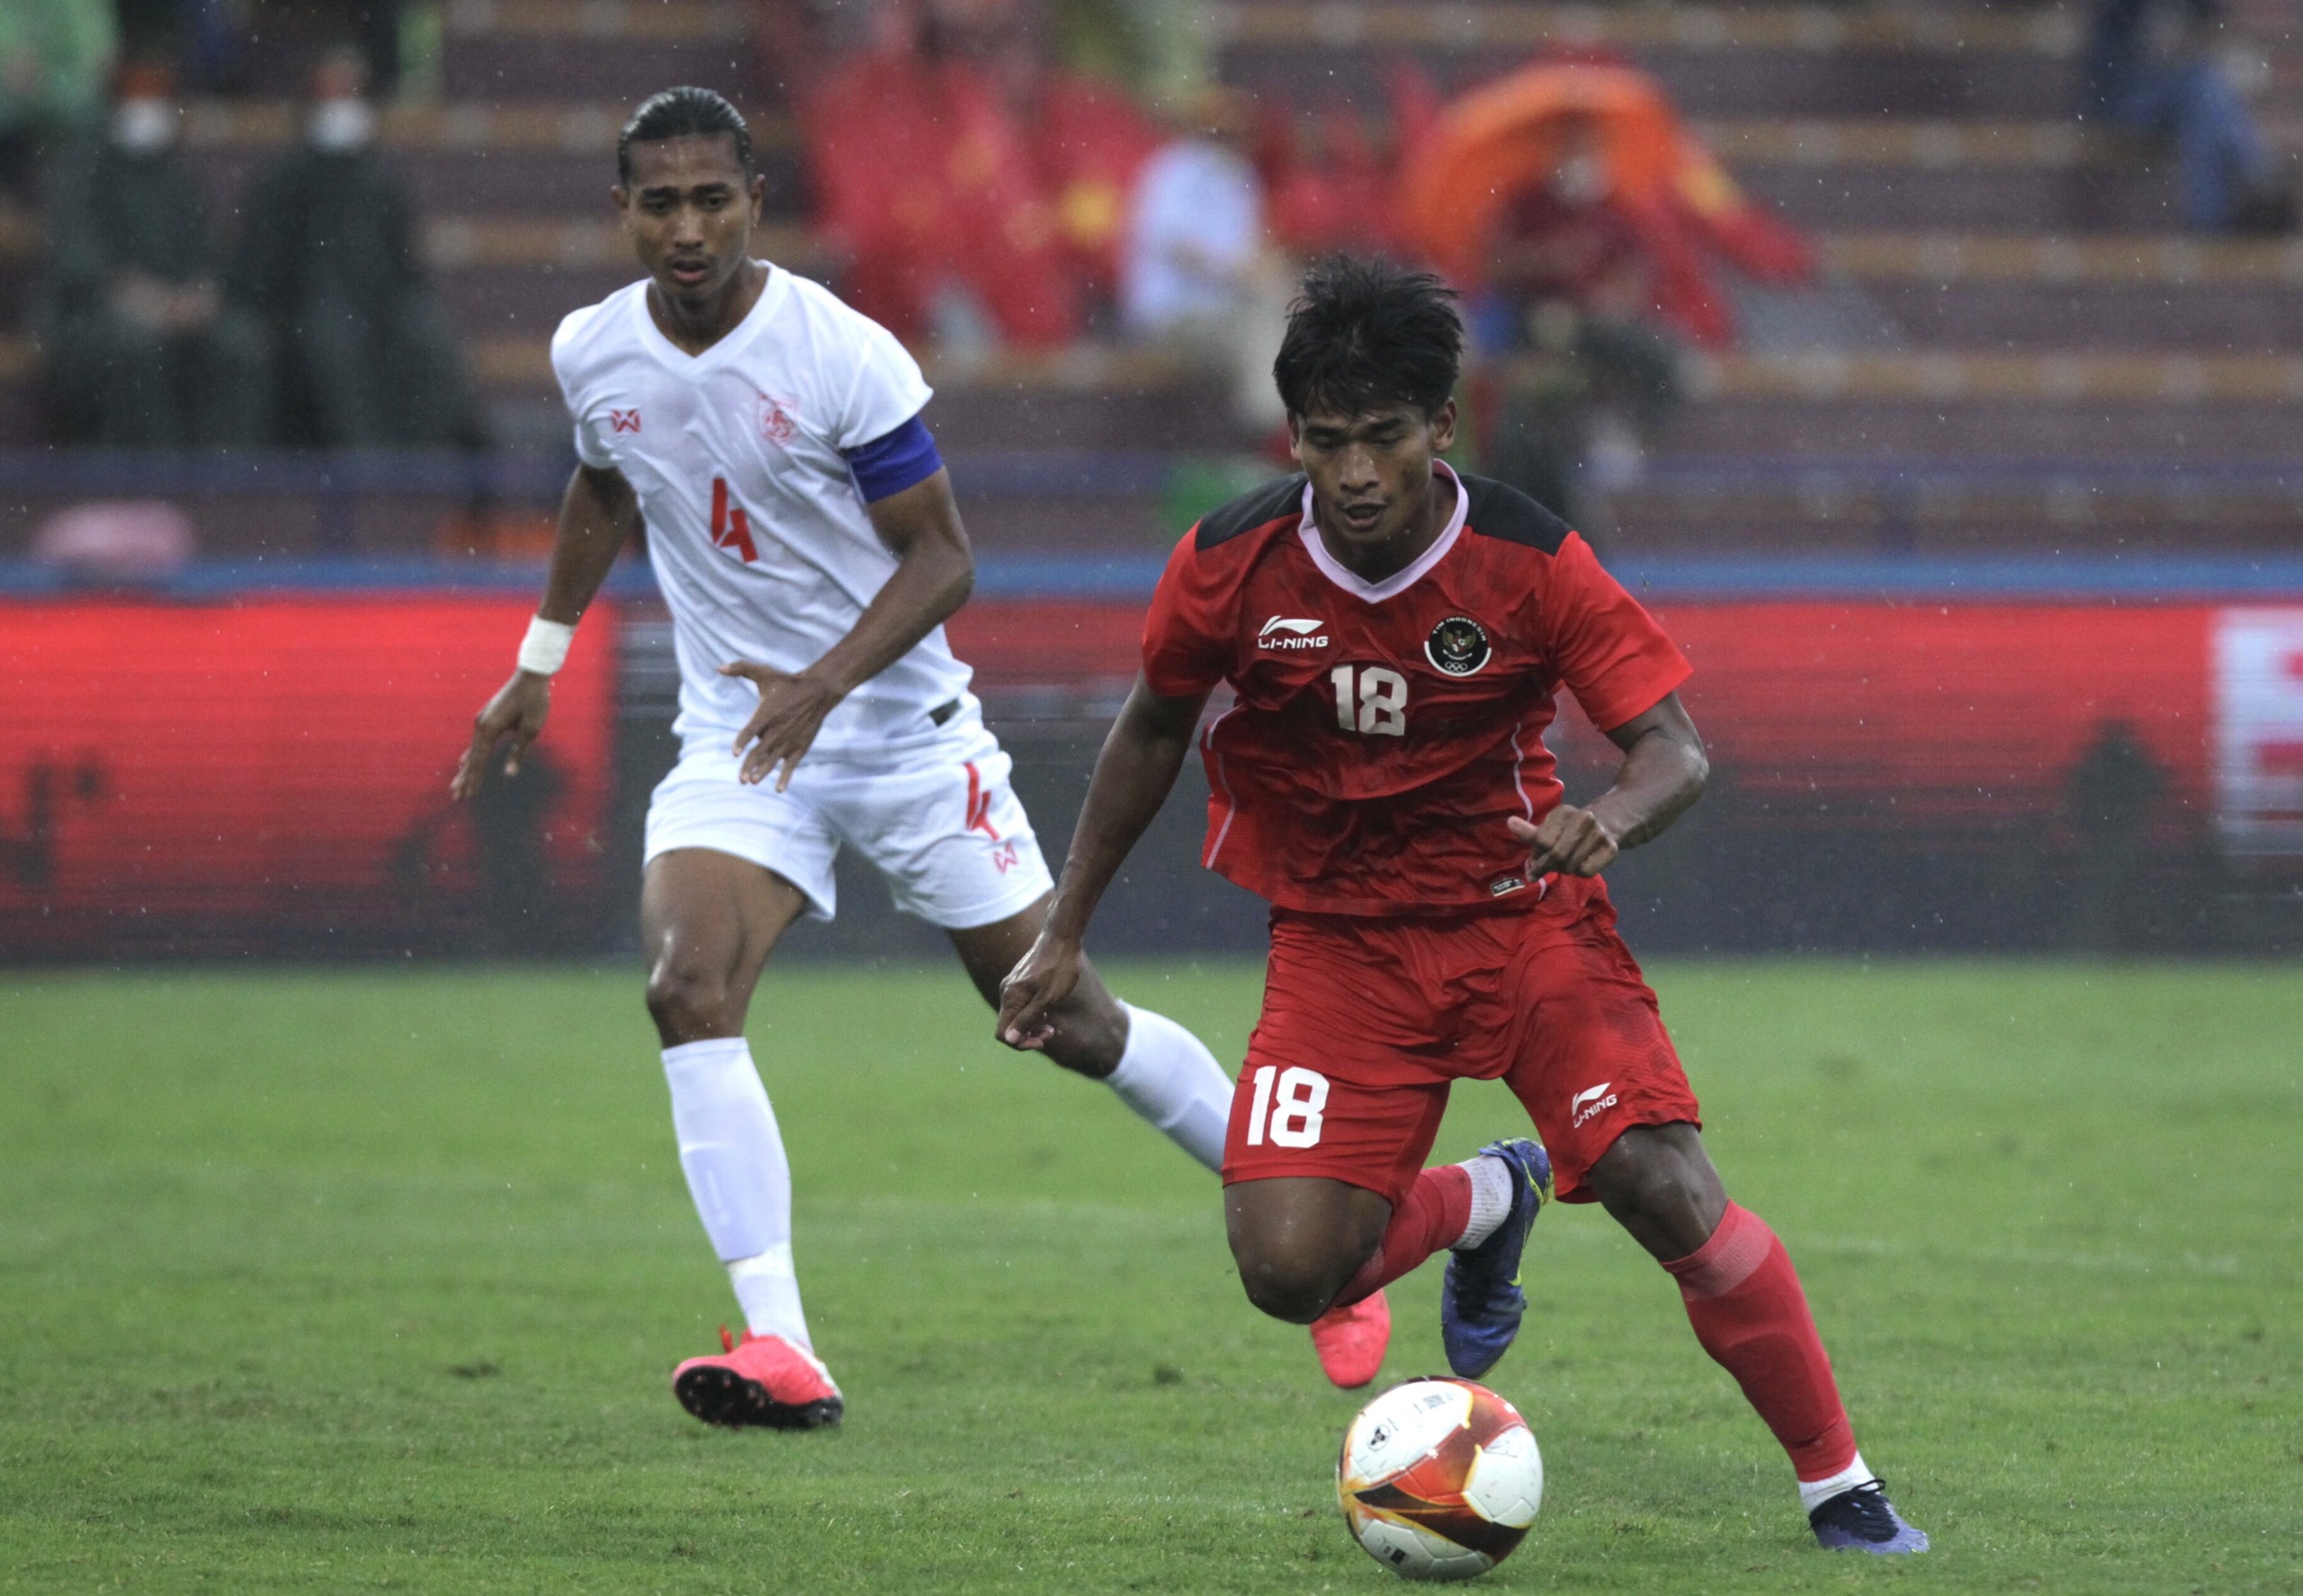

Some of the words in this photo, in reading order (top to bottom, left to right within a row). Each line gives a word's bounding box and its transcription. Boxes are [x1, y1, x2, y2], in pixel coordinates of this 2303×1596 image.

[711, 476, 758, 562] 4
[1258, 635, 1329, 649] LI-NING
[1432, 622, 1445, 635] TIM
[1331, 664, 1408, 736] 18
[963, 761, 1000, 841] 4
[1247, 1065, 1330, 1148] 18
[1573, 1093, 1617, 1128] LI-NING
